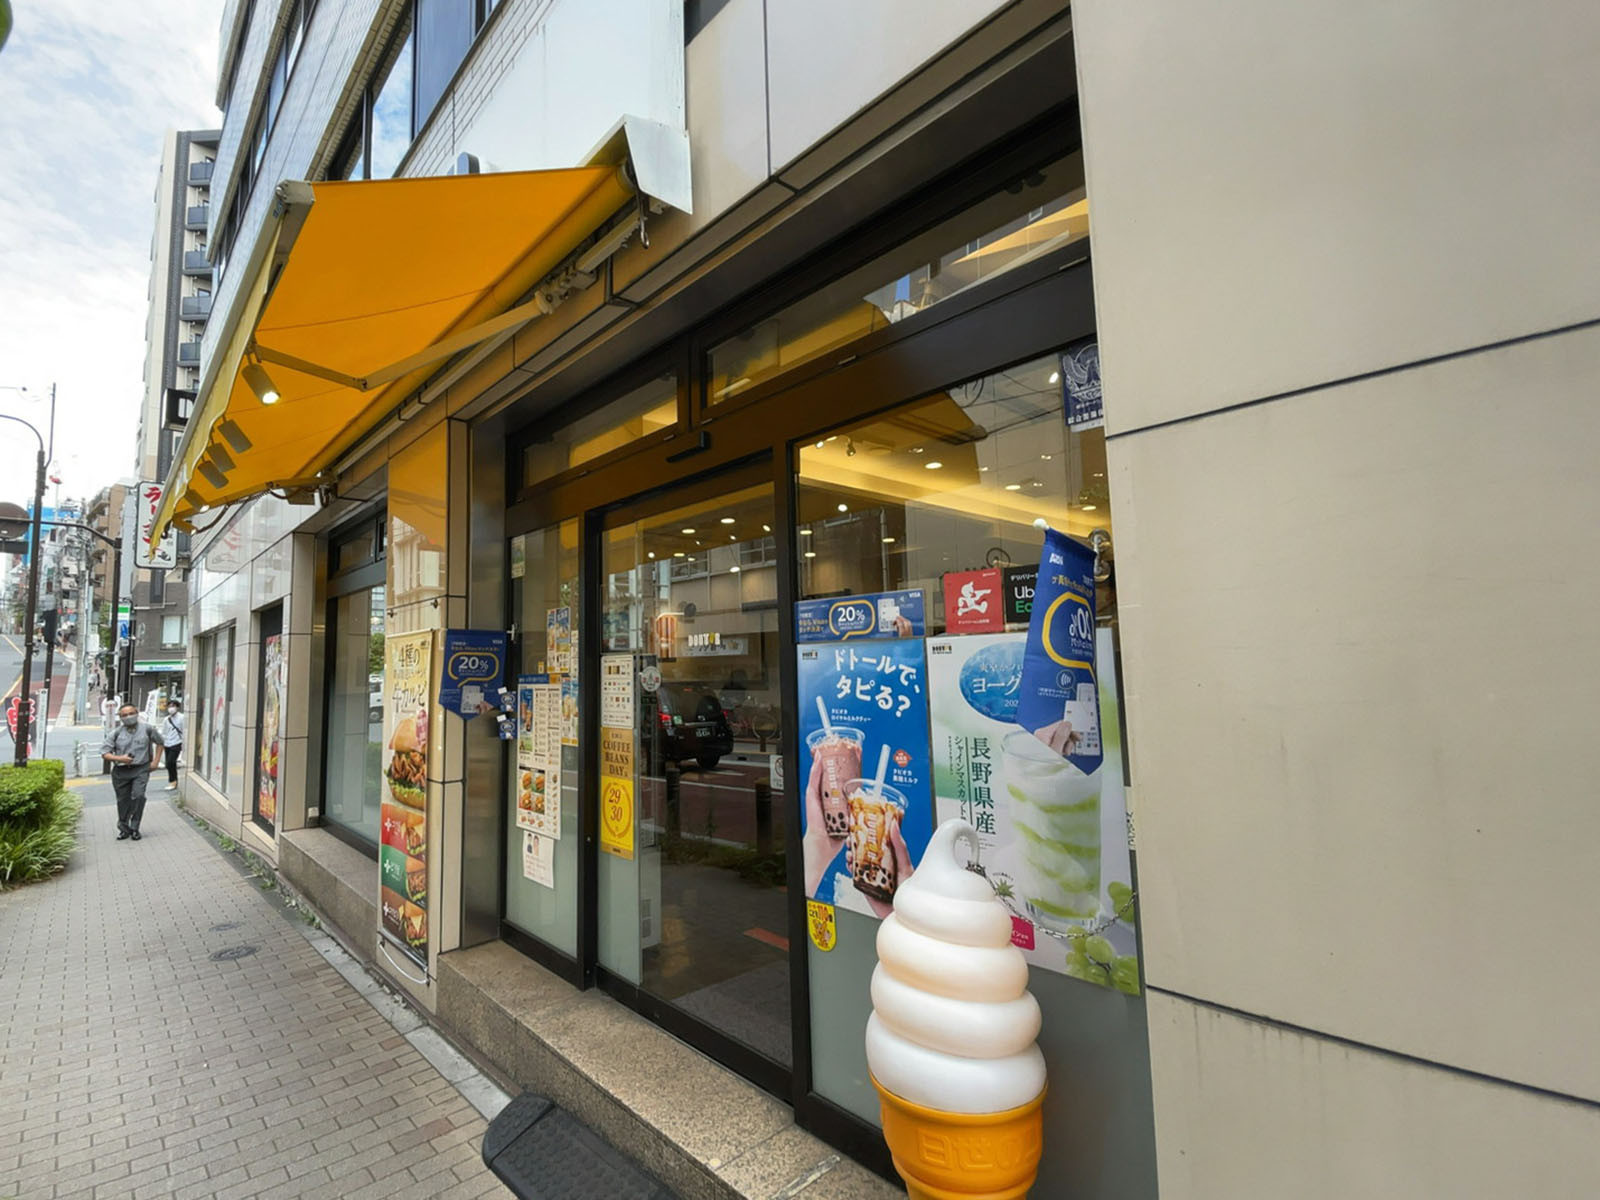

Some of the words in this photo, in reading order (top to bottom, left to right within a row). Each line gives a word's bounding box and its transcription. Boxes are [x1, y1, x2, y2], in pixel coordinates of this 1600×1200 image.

[837, 606, 866, 622] 20%
[458, 656, 489, 671] 20%
[603, 740, 631, 754] COFFEE
[970, 737, 997, 836] 長野県産
[608, 788, 621, 804] 29
[610, 806, 623, 822] 30
